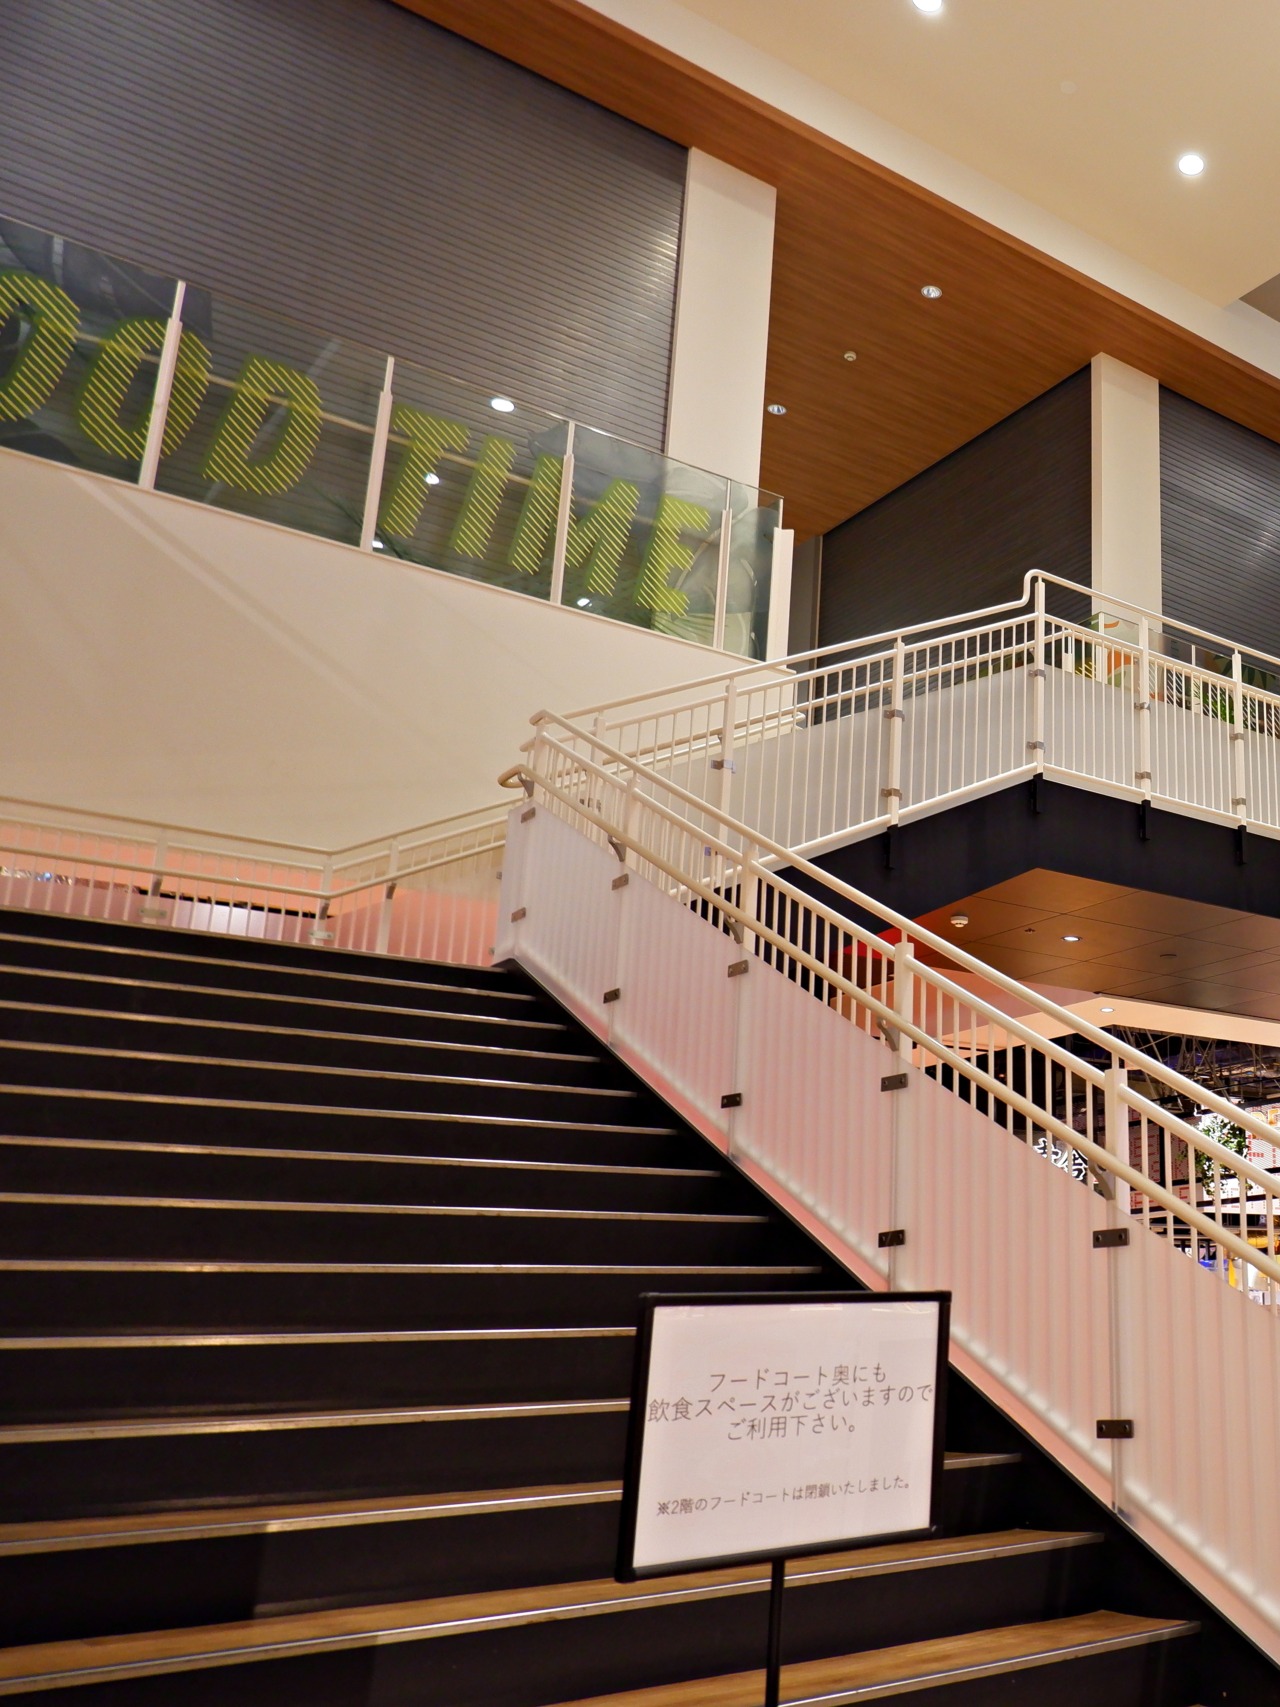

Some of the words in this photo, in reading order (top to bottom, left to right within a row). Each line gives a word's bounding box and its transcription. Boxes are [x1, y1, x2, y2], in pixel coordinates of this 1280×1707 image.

[382, 405, 711, 617] TIME
[709, 1362, 887, 1393] フードコート奥にも
[647, 1384, 933, 1423] 飲食スペースがございますので
[726, 1414, 856, 1442] ご利用下さい。
[655, 1475, 911, 1517] ※2階のフードコートは閉鎖いたしました。
